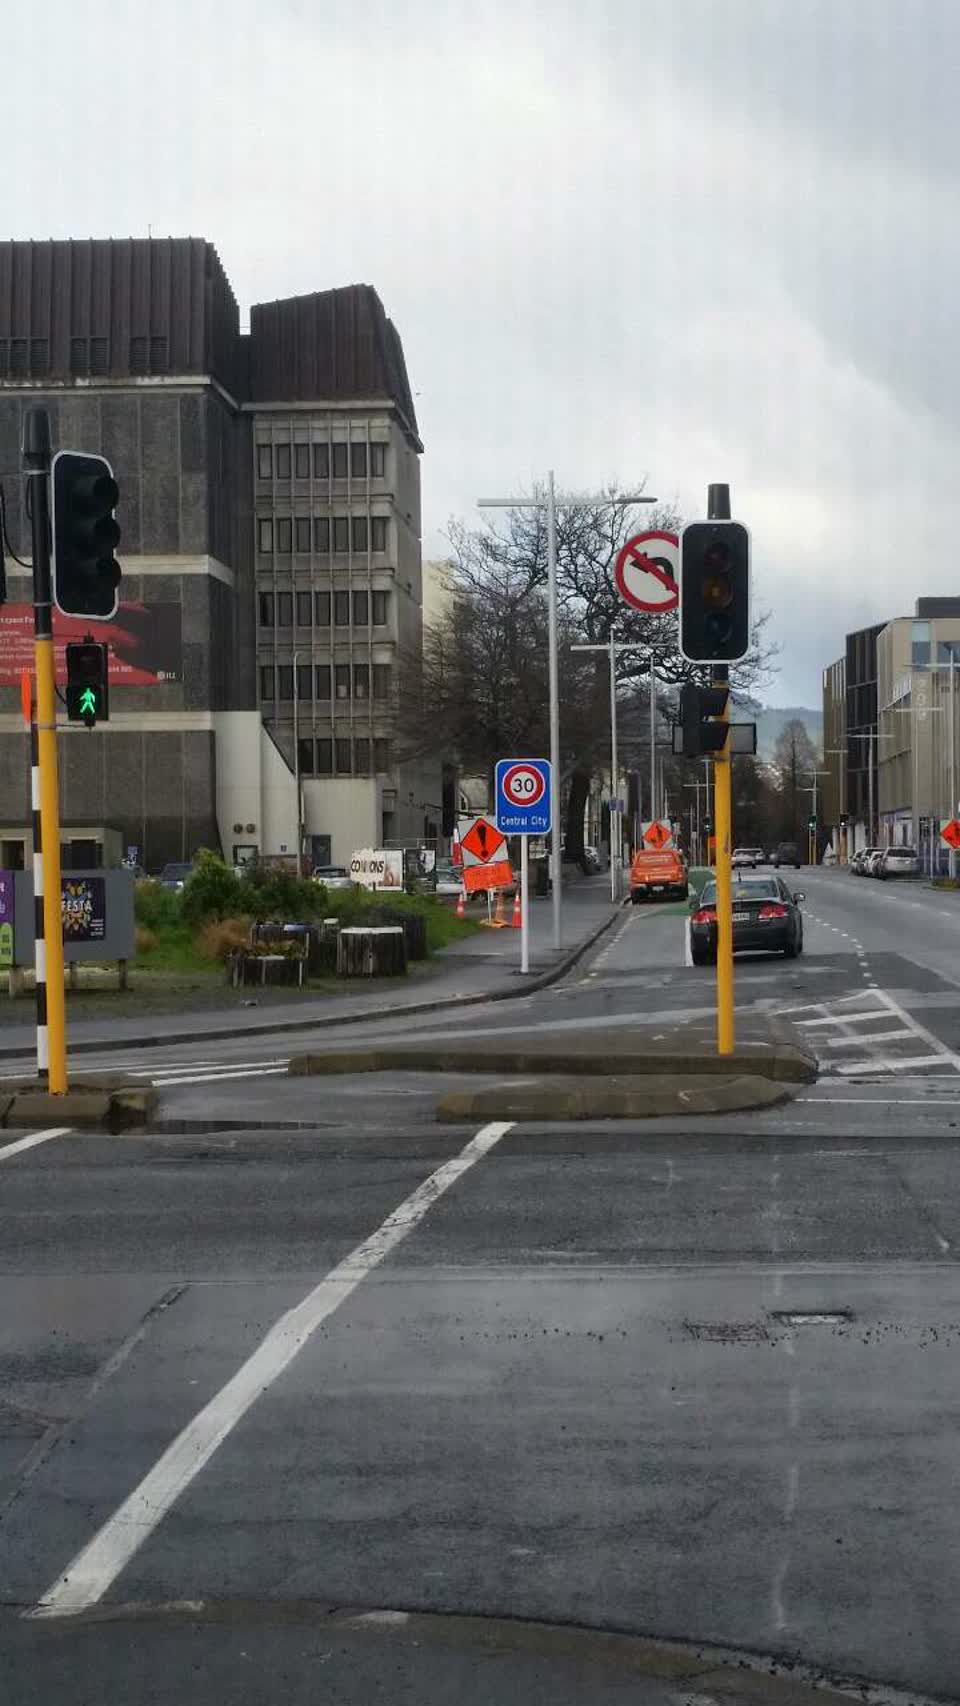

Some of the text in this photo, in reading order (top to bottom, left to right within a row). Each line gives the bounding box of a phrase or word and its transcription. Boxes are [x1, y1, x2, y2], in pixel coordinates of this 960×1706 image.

[513, 778, 534, 793] 30
[500, 815, 548, 828] Central City
[350, 859, 384, 873] COONS
[61, 899, 93, 912] FESTA
